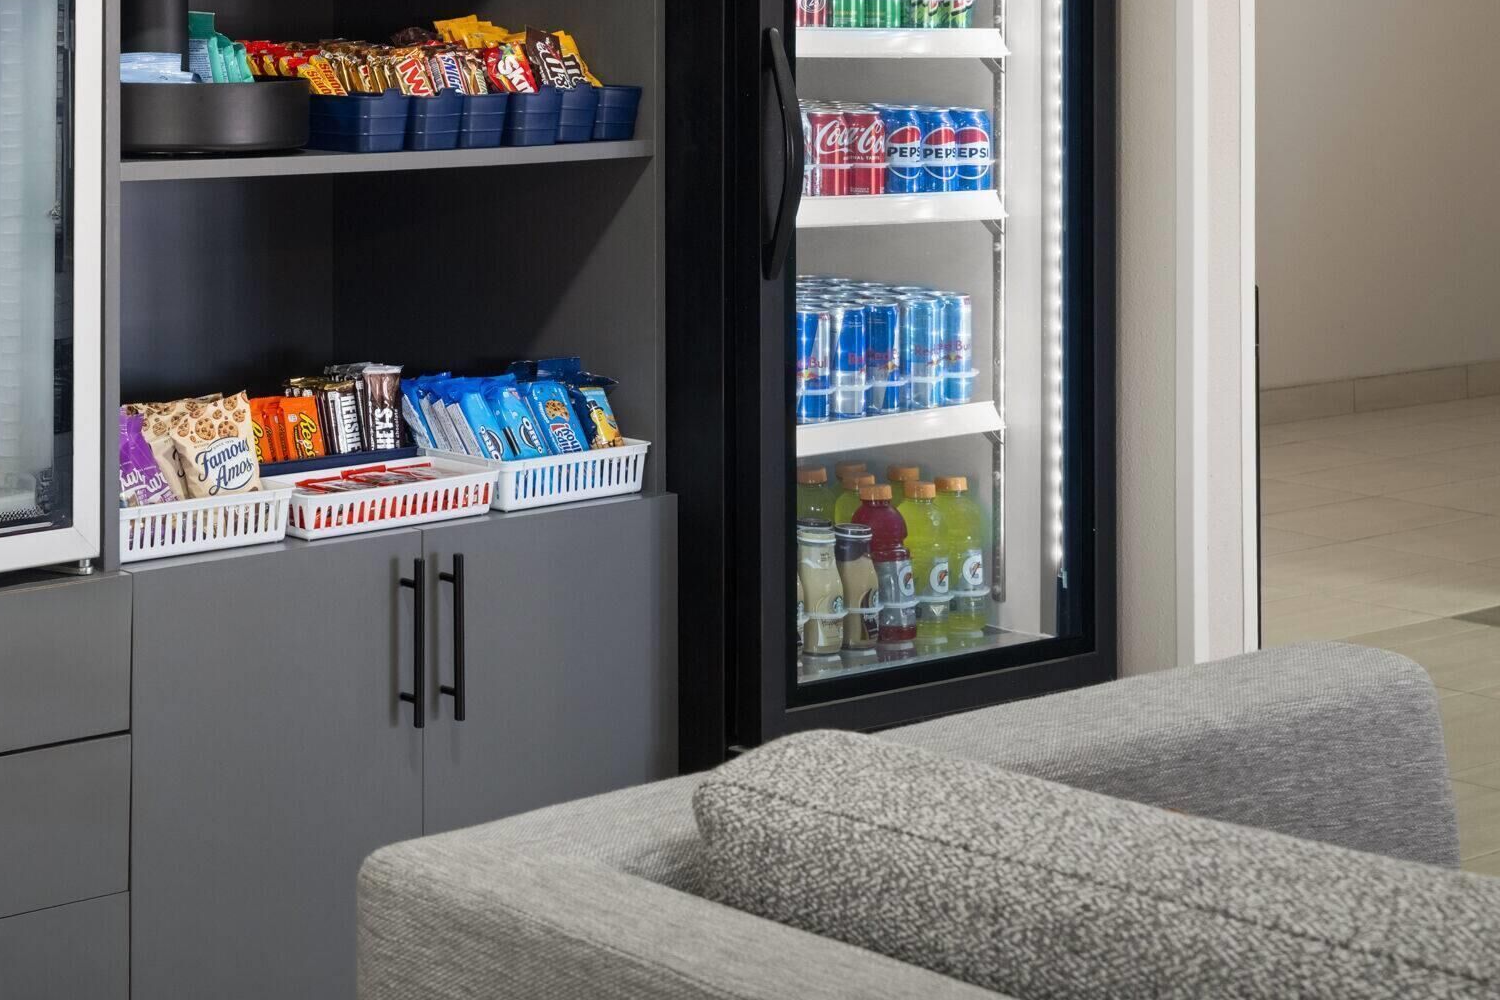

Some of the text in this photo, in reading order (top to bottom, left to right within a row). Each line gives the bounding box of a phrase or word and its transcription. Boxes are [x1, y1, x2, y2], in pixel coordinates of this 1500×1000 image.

[887, 146, 921, 158] PEPS
[923, 147, 956, 158] PEPS
[957, 146, 989, 158] EPSI
[195, 436, 250, 482] Famous
[209, 457, 254, 496] Amos
